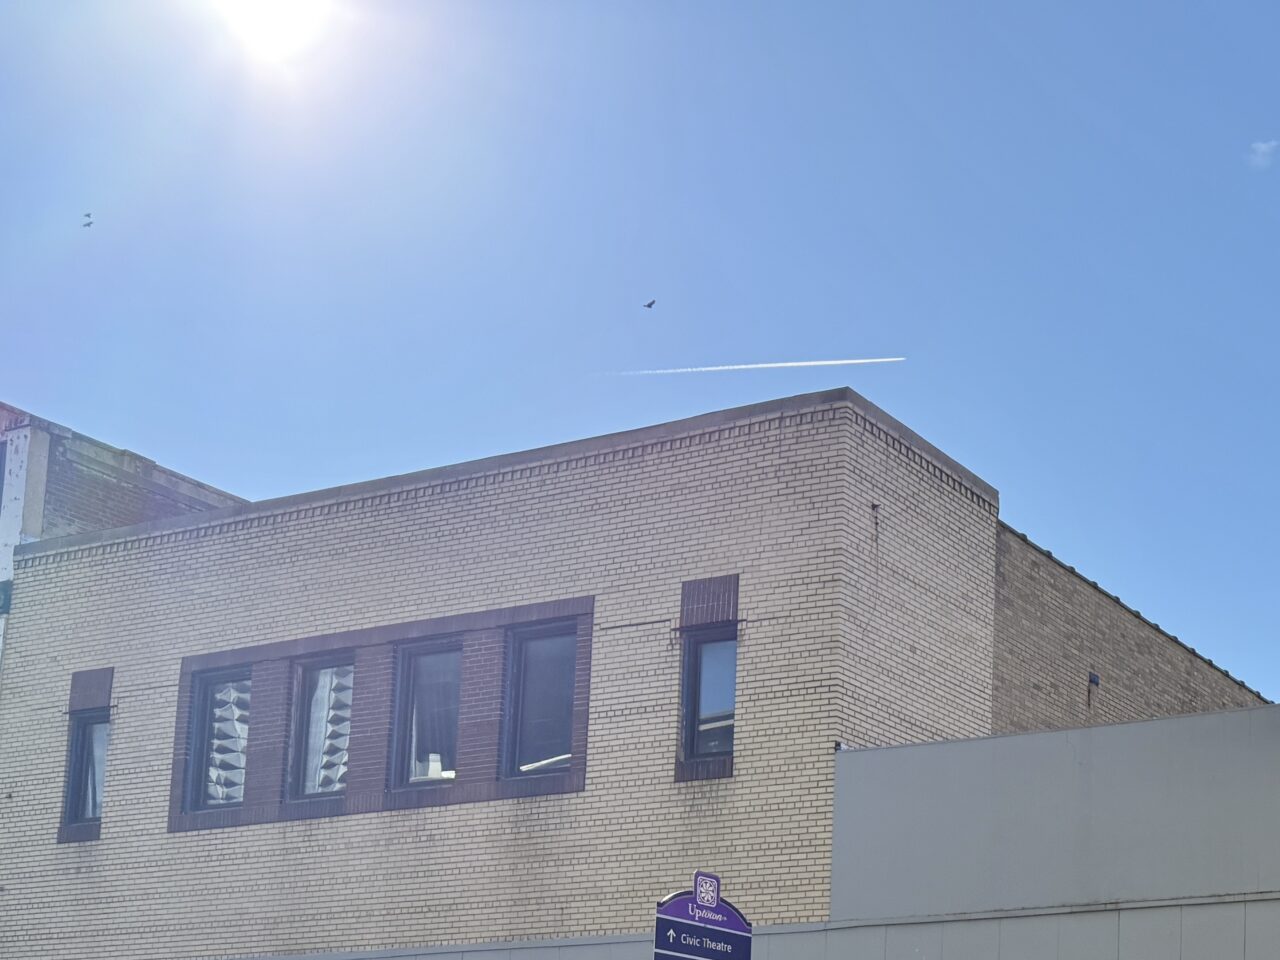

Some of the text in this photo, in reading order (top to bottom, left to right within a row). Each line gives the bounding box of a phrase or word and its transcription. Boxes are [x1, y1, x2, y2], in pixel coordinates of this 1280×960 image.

[688, 903, 723, 921] Uptown
[681, 934, 733, 953] Civic Theatre
